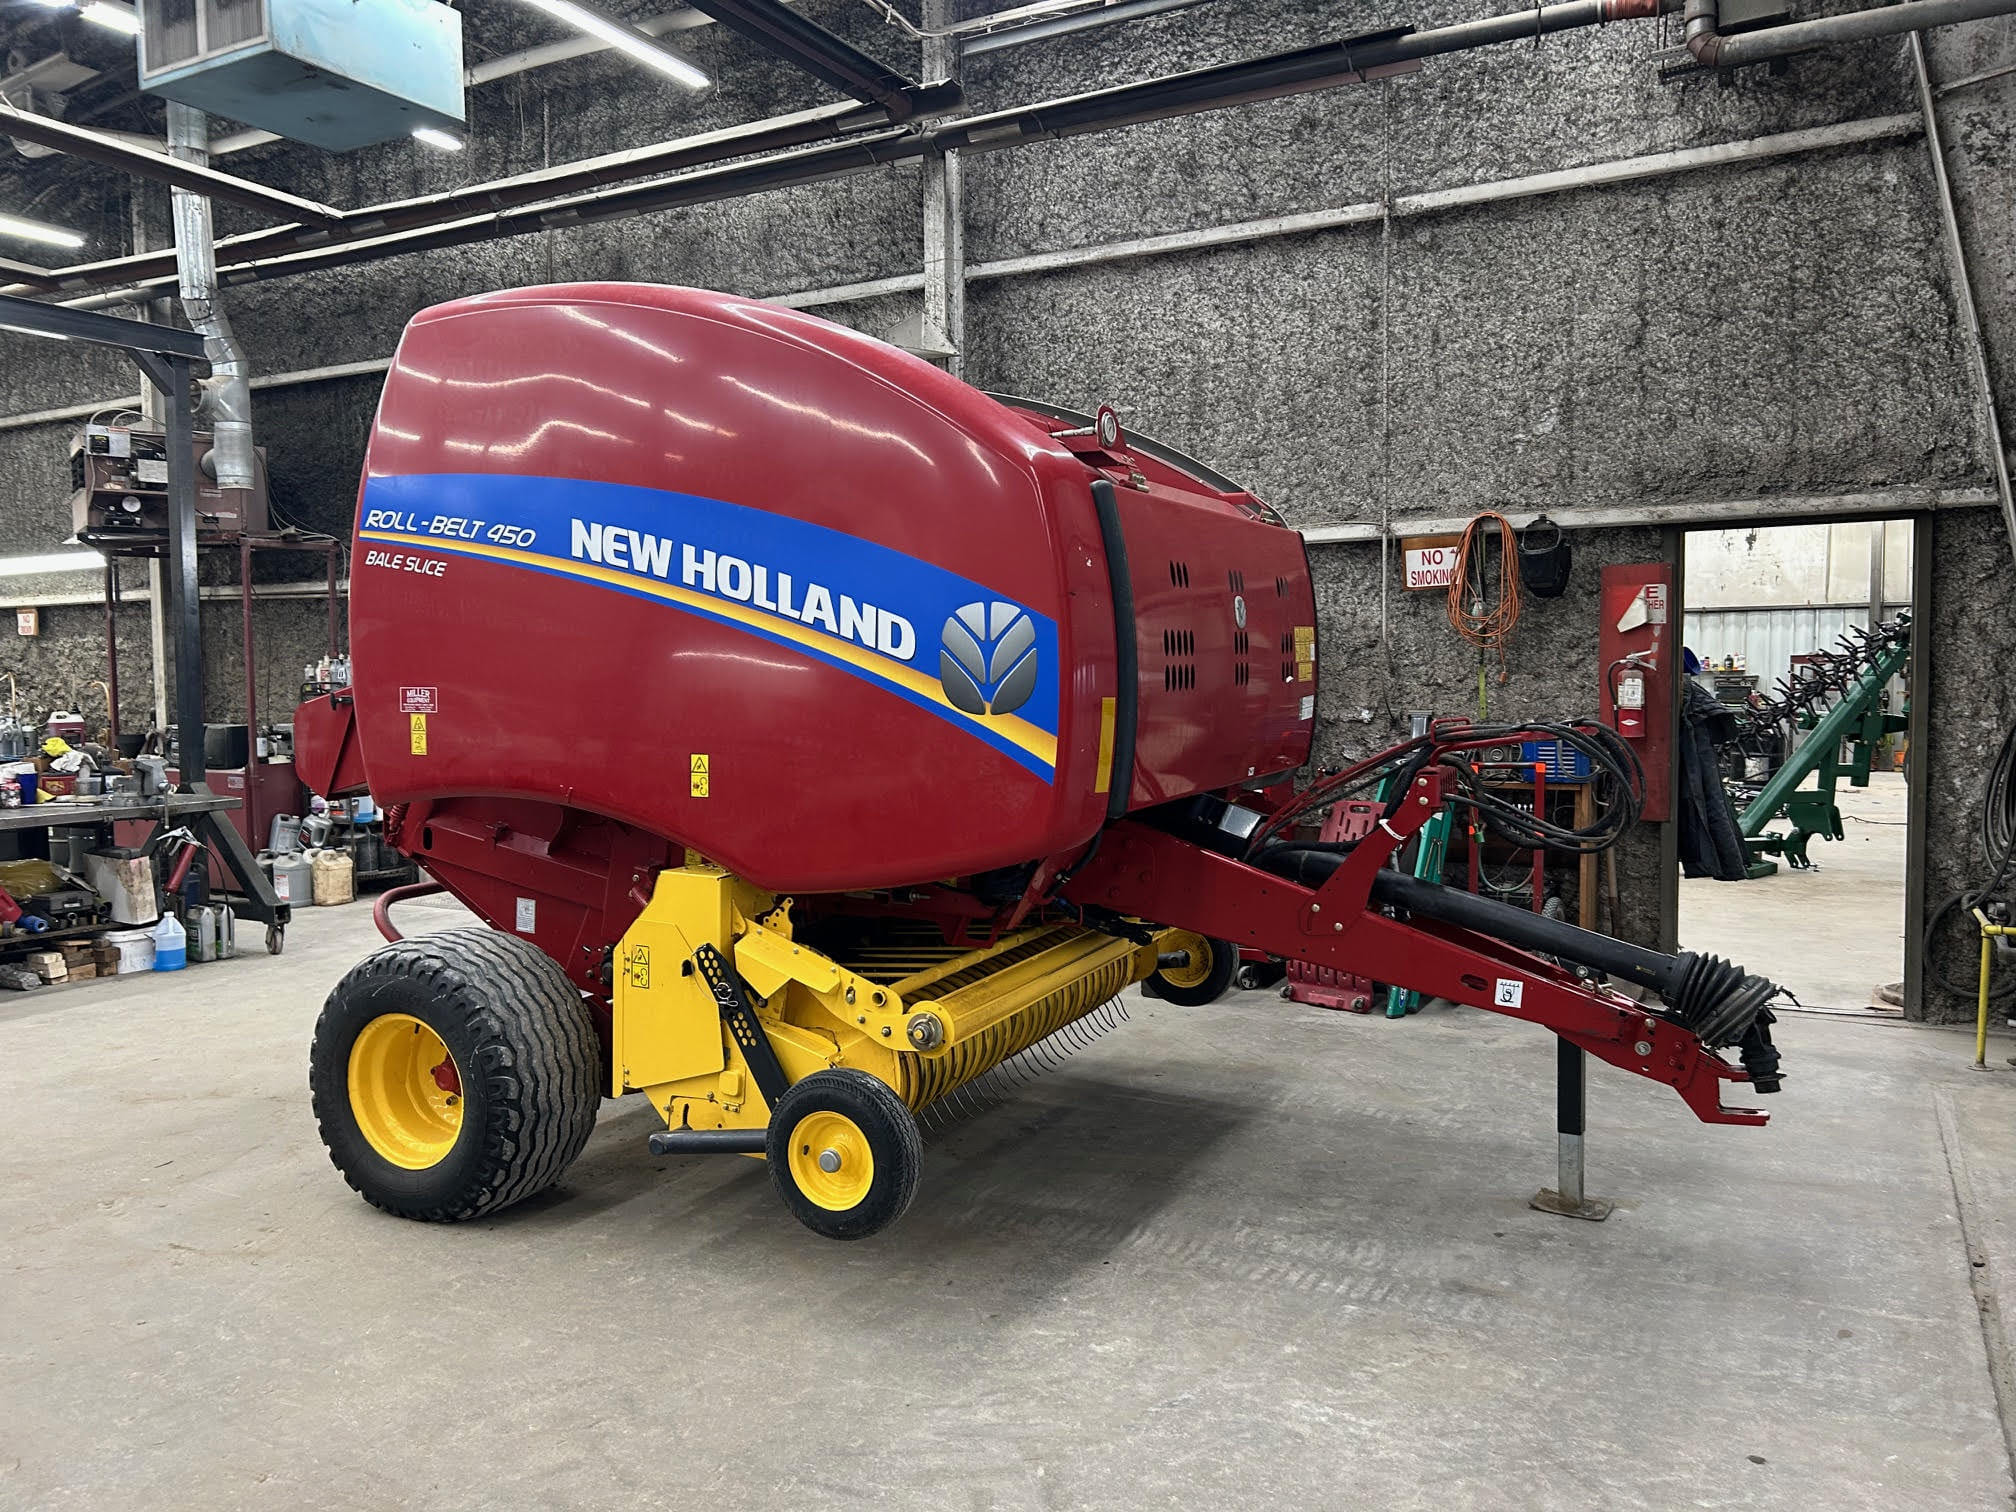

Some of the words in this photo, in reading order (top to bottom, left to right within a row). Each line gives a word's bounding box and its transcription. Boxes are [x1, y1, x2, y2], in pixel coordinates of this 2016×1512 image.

[487, 524, 537, 547] 450
[365, 550, 403, 570] BALE
[403, 556, 448, 577] SLICE
[1421, 550, 1443, 565] NO
[571, 518, 673, 579] NEW
[682, 543, 916, 661] HOLLAND
[1646, 599, 1664, 610] HER
[407, 689, 430, 698] MILLER
